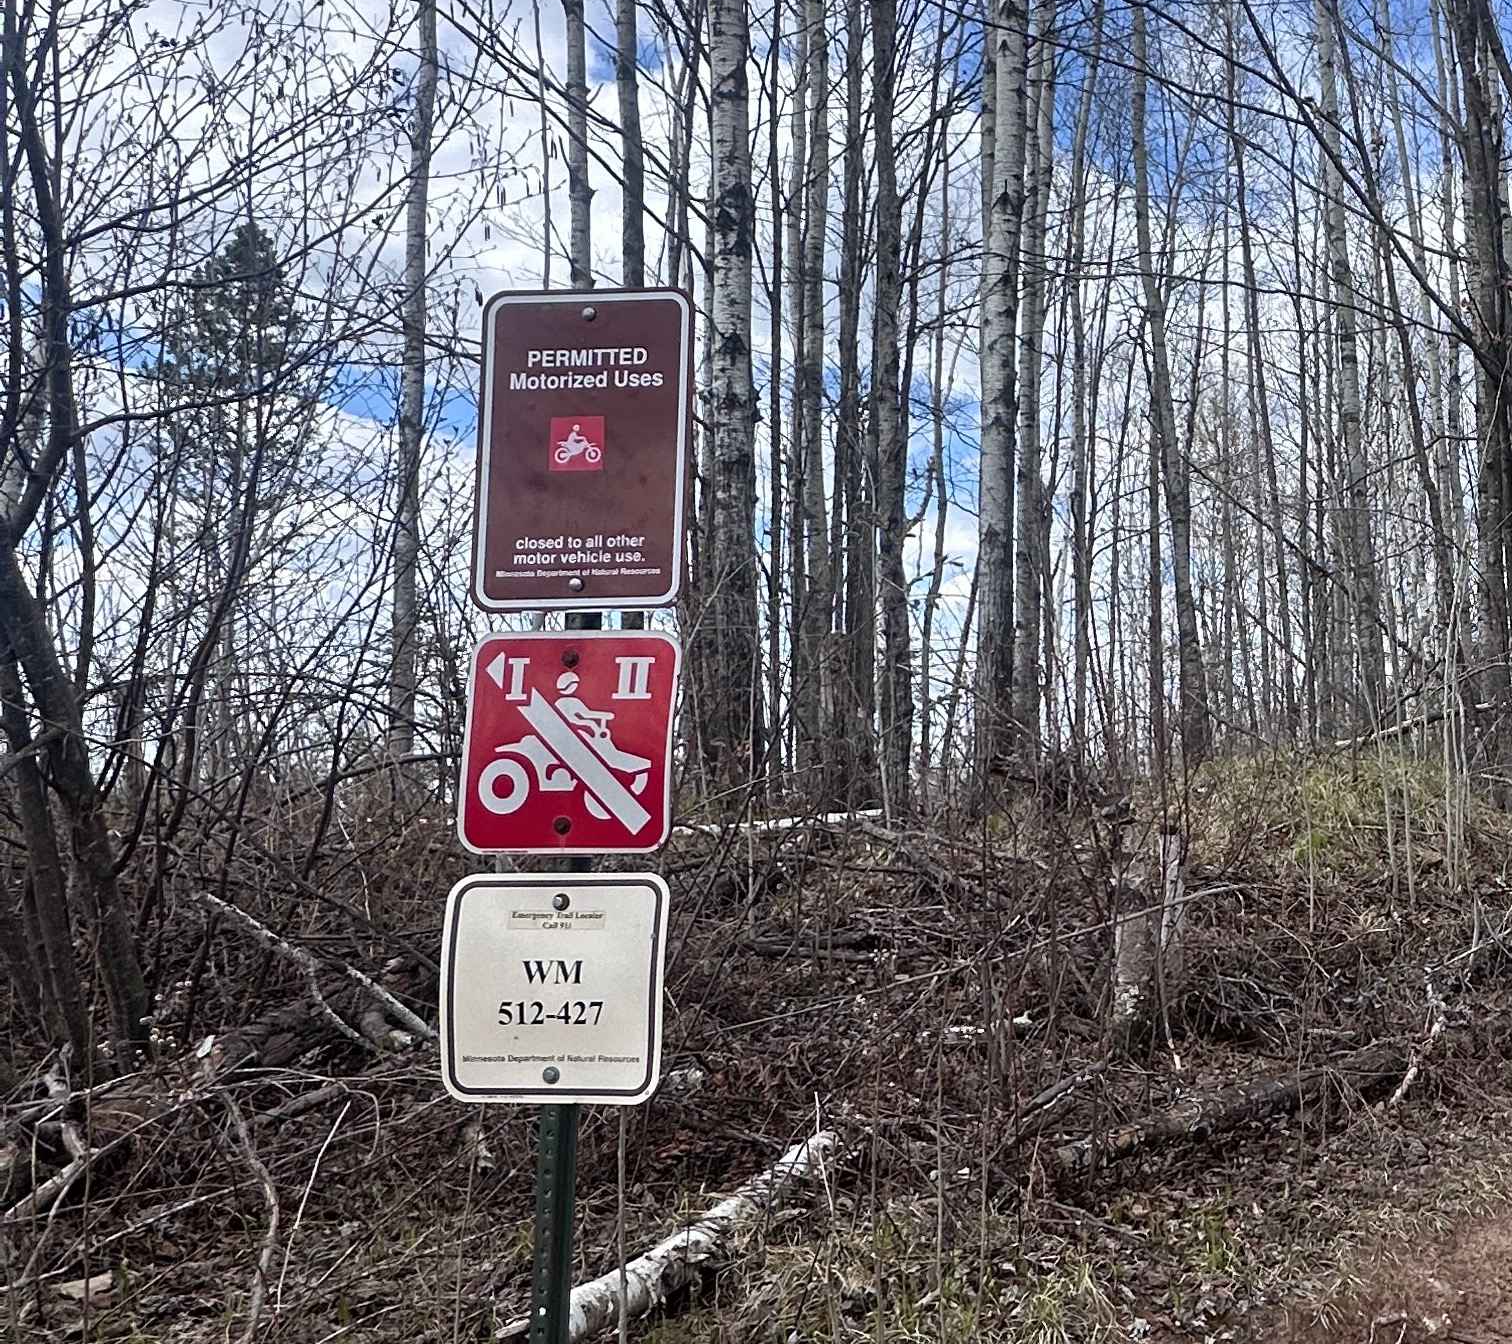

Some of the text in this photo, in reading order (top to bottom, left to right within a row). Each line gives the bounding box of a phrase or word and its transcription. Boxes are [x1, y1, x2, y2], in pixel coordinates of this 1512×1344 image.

[527, 347, 648, 368] PERMITTED
[509, 370, 664, 390] Motorized Uses
[515, 534, 646, 550] closed to all other
[513, 550, 646, 565] motor vehicle use.
[611, 656, 656, 700] II
[522, 959, 584, 985] WM
[498, 1000, 604, 1026] 512-427
[462, 1055, 506, 1063] Minnesota
[507, 1055, 555, 1064] Department
[567, 1055, 596, 1063] Natural
[598, 1055, 640, 1063] Resources
